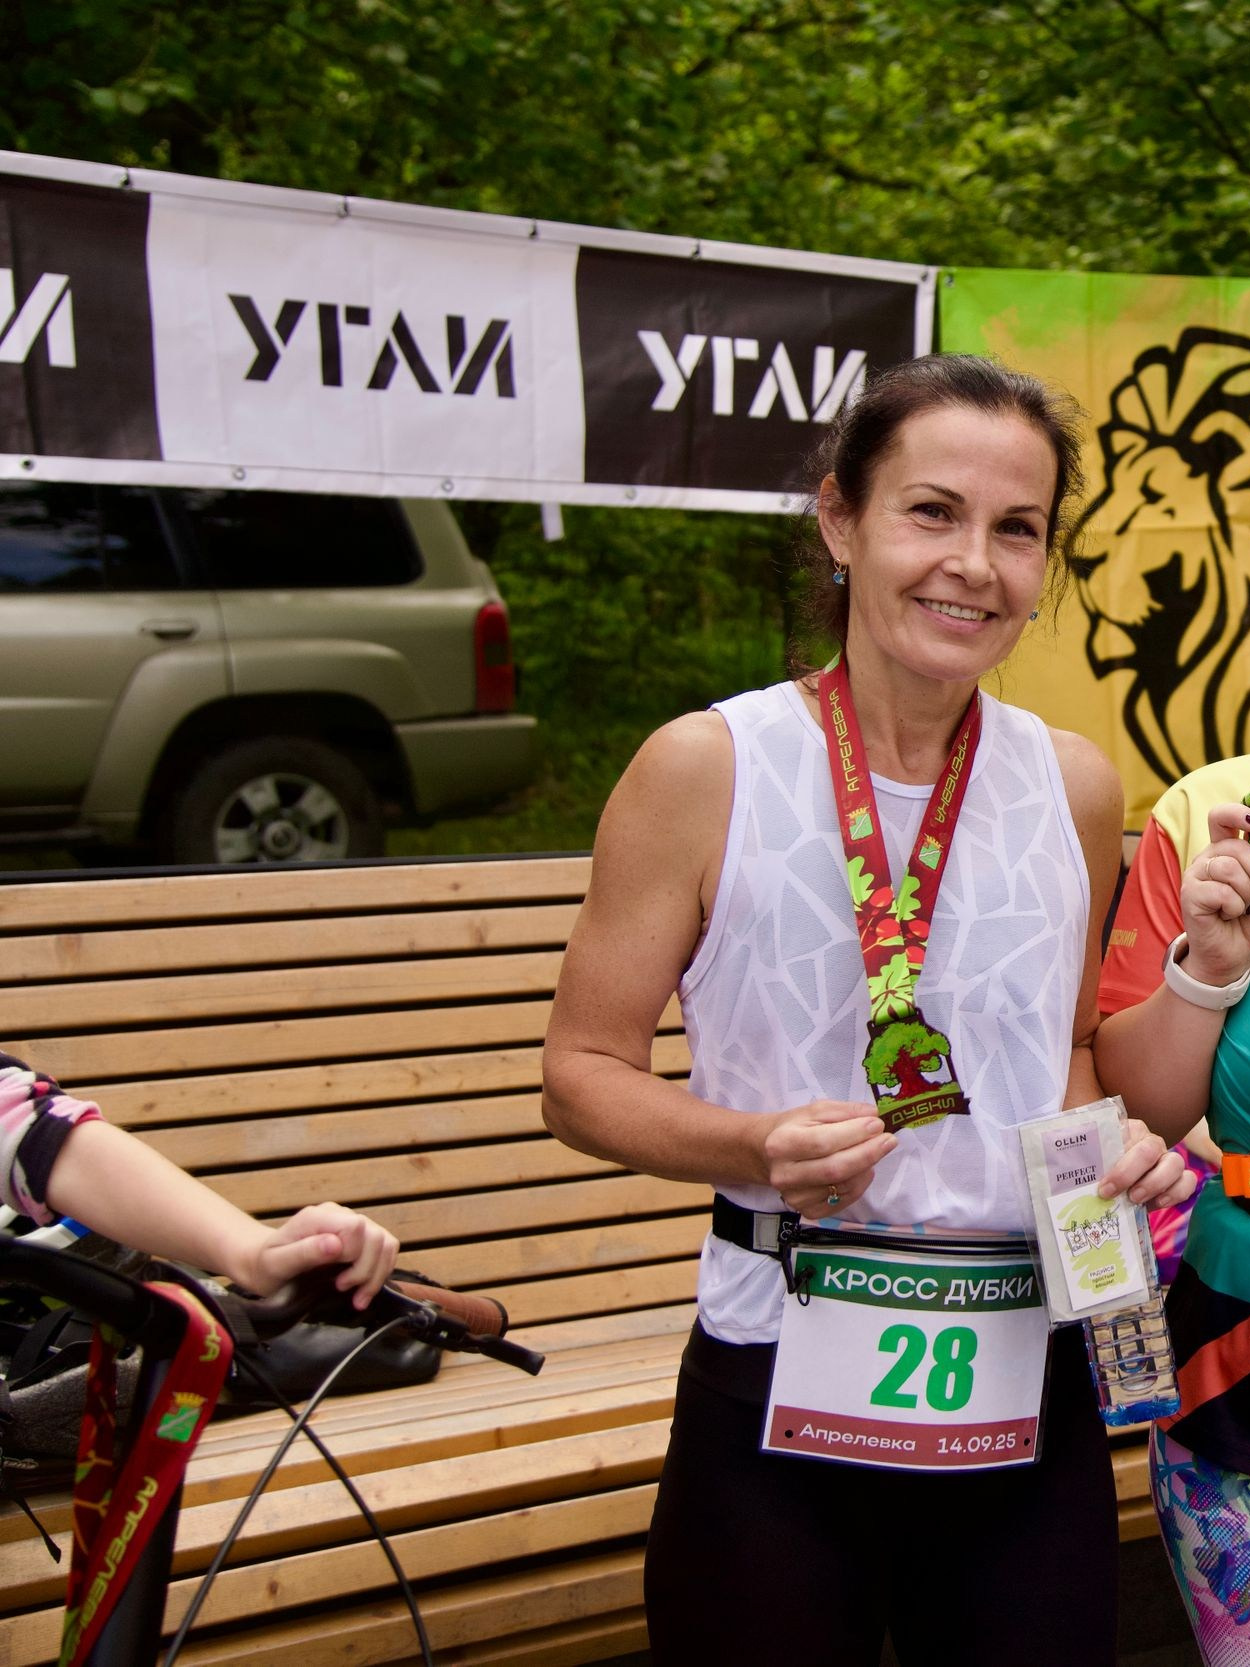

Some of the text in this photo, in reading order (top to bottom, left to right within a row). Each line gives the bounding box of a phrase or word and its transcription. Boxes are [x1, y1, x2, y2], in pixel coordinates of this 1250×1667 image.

[228, 293, 517, 399] УГЛИ
[637, 330, 868, 424] УГЛИ
[828, 687, 860, 791] АПРЕЛЕВКА
[891, 1097, 956, 1125] ДУБКИ
[1054, 1134, 1087, 1148] OLLIN
[1056, 1165, 1097, 1182] PERFECT
[1074, 1174, 1097, 1186] HAIR
[823, 1265, 1034, 1305] КРОСС ДУБКИ
[870, 1323, 978, 1412] 28
[799, 1423, 1017, 1455] Апрелевка 14.09.25
